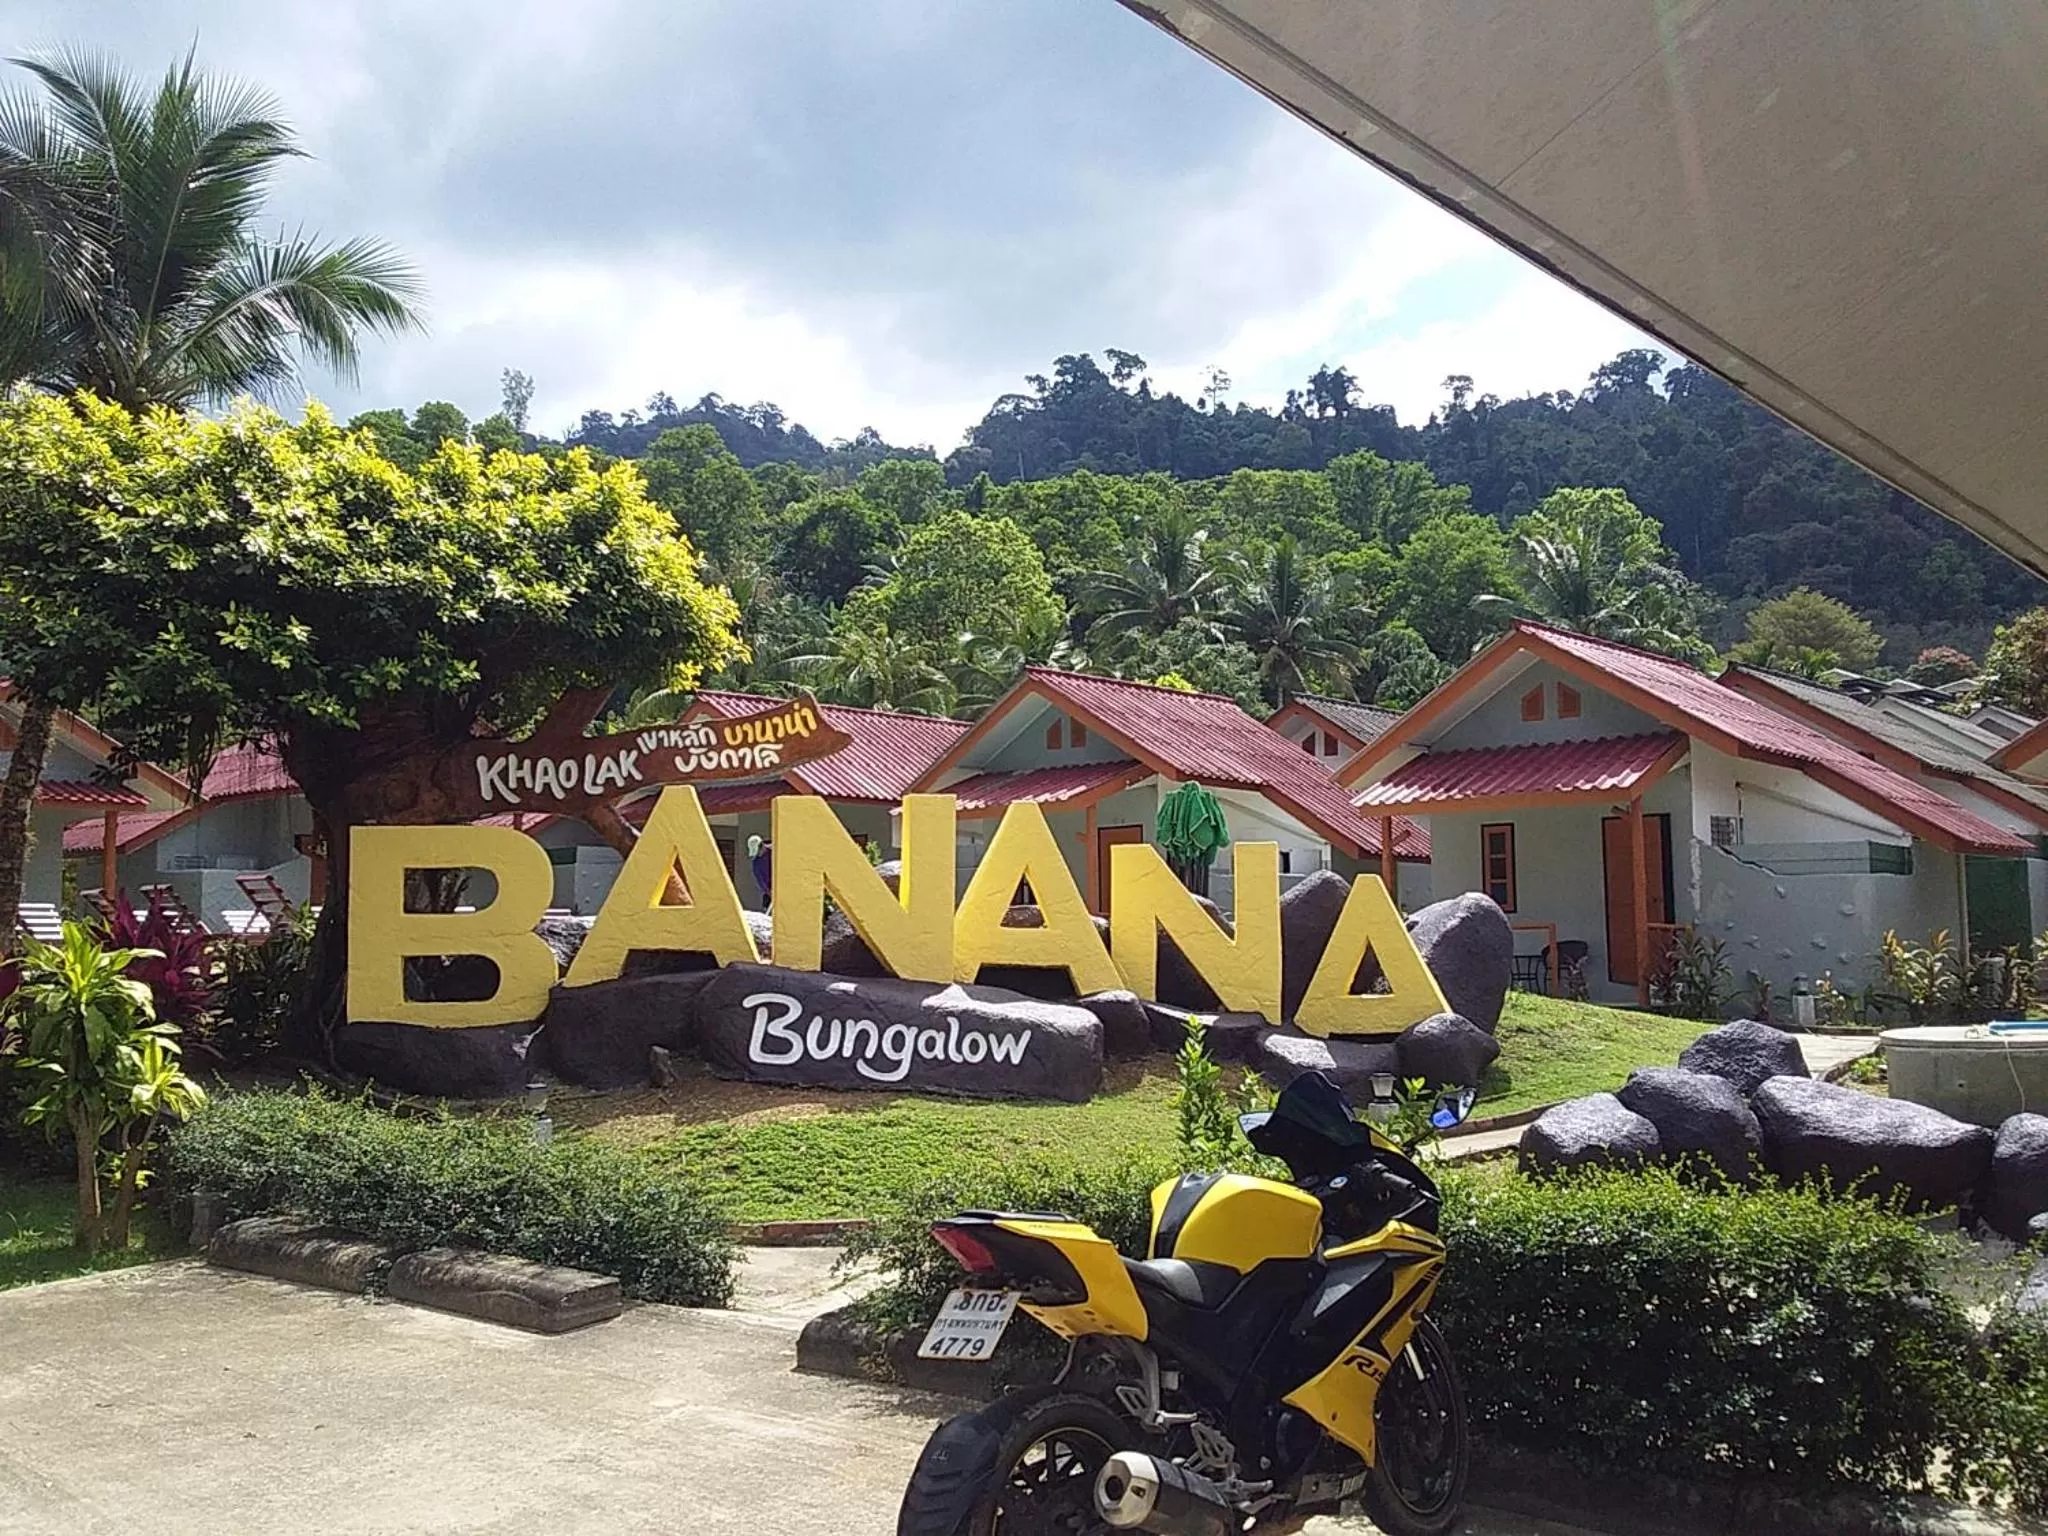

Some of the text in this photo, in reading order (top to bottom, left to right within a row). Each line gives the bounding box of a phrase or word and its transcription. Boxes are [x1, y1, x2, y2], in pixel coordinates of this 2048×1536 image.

[636, 724, 718, 755] เขาหลัก
[347, 785, 1452, 1037] BANANA
[742, 993, 1031, 1081] Bungalow
[930, 1336, 985, 1357] 4779
